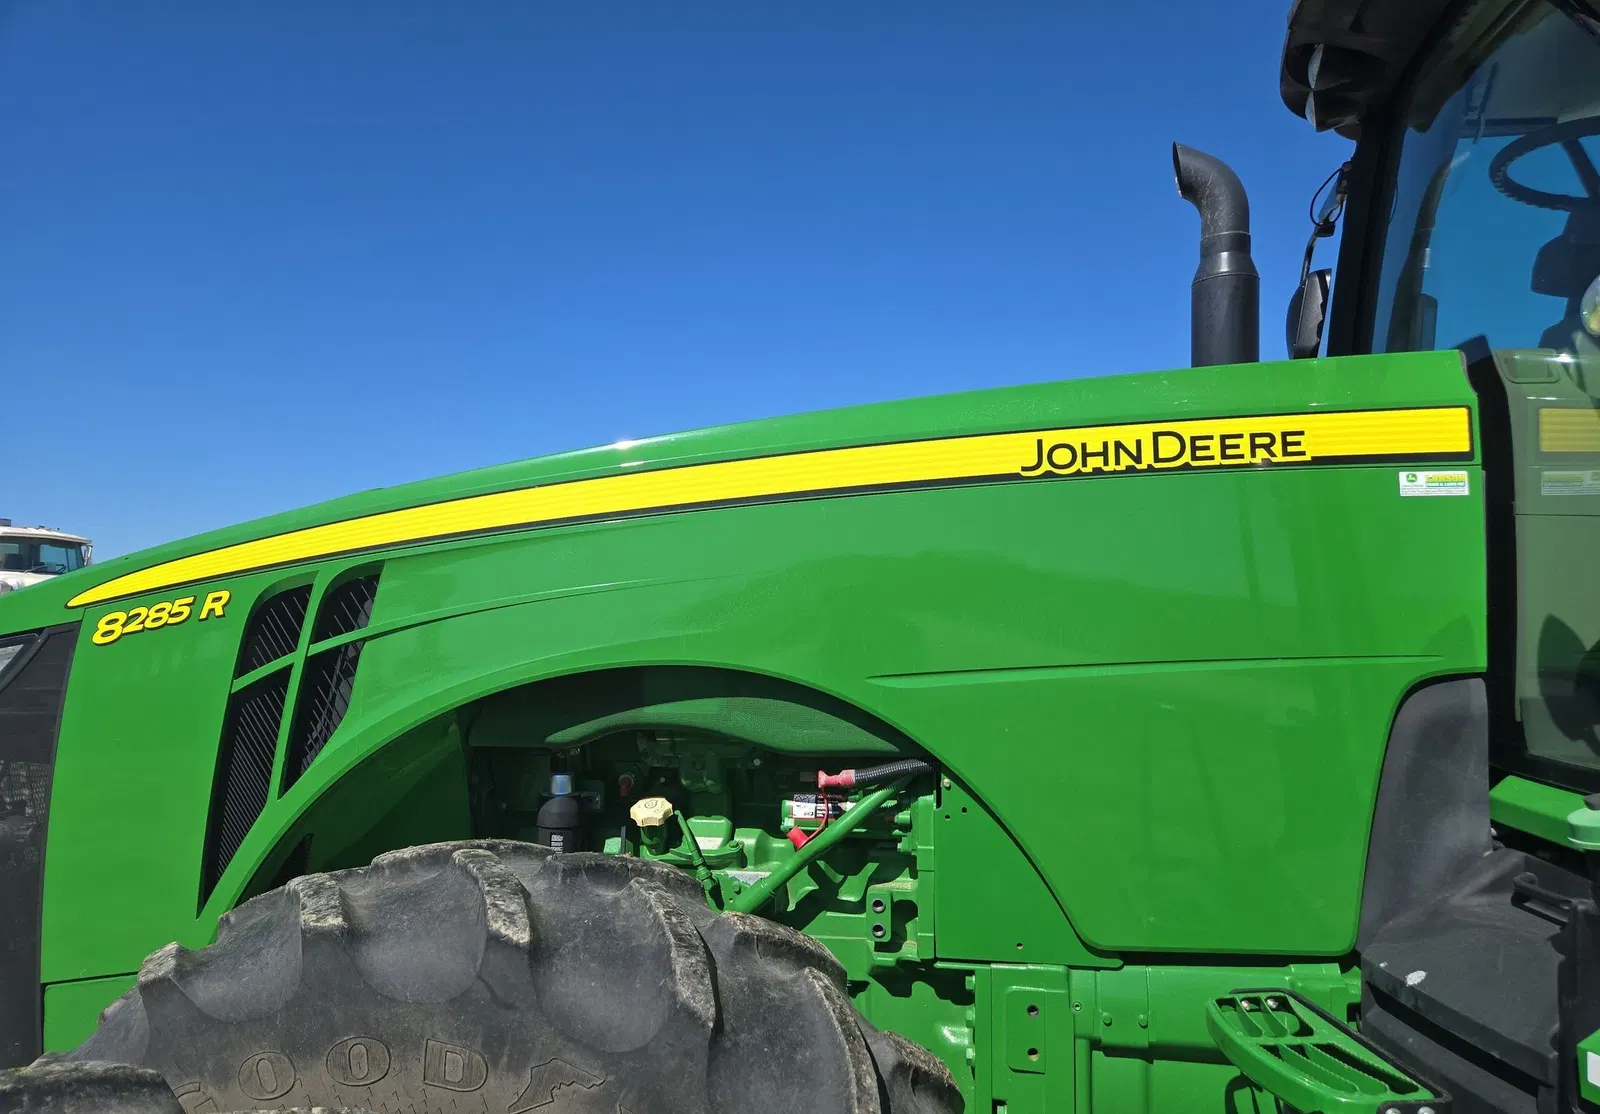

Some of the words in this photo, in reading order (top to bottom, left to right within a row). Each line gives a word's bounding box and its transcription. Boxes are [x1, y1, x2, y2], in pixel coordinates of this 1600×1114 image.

[1020, 438, 1142, 473] JOHN
[1151, 430, 1307, 465] DEERE
[92, 596, 196, 646] 8285
[198, 589, 231, 622] R
